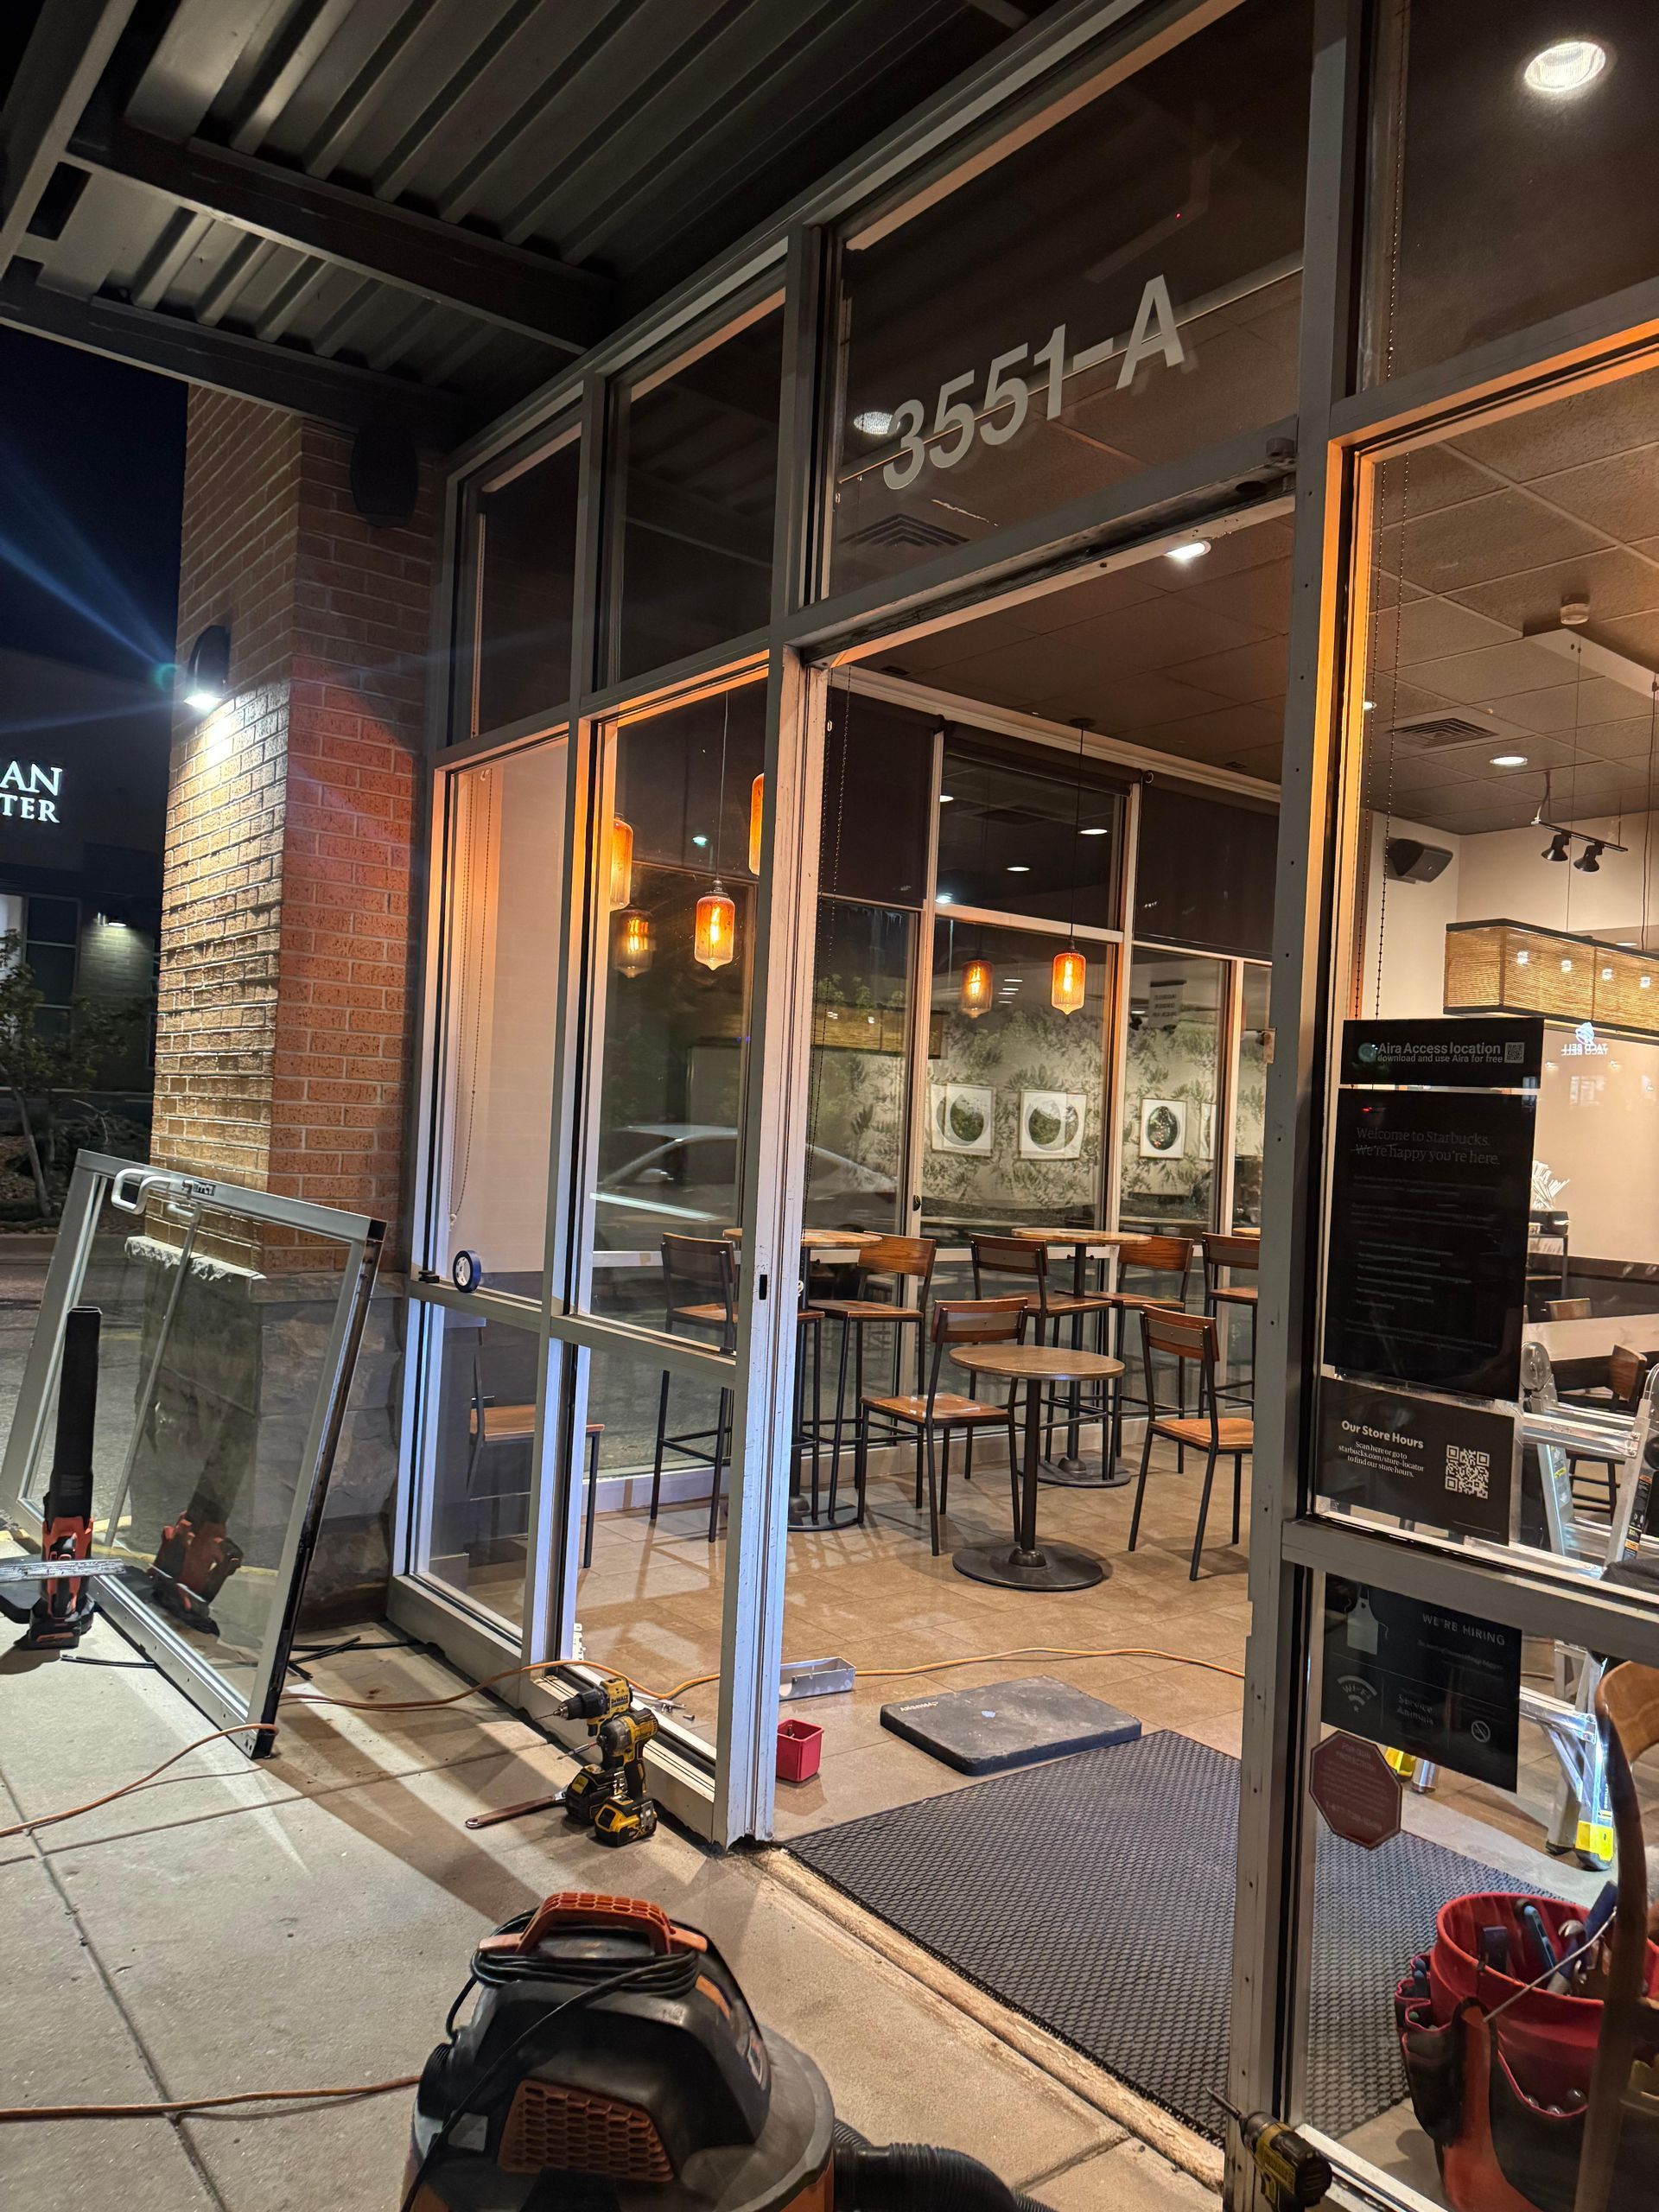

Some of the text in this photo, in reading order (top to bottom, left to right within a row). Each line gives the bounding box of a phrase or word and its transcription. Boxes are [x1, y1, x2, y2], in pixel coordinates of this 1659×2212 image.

[883, 274, 1185, 490] 3551-A
[0, 792, 60, 823] TER
[1376, 1053, 1503, 1064] download and use Aira for free
[1378, 1042, 1501, 1054] Aira Access location
[1356, 1127, 1491, 1147] Welcome to Starbucks.
[1356, 1143, 1501, 1166] We're happy you're here.
[1341, 1420, 1424, 1449] Our Store Hours
[1338, 1445, 1425, 1471] starbucks.com/store-locator
[1355, 1440, 1370, 1451] Scan
[1370, 1444, 1384, 1453] here
[1391, 1449, 1400, 1459] go
[1400, 1450, 1408, 1459] to
[1354, 1456, 1366, 1465] find
[1366, 1459, 1378, 1468] our
[1378, 1462, 1395, 1473] store
[1421, 1612, 1506, 1646] WE'RE HIRING
